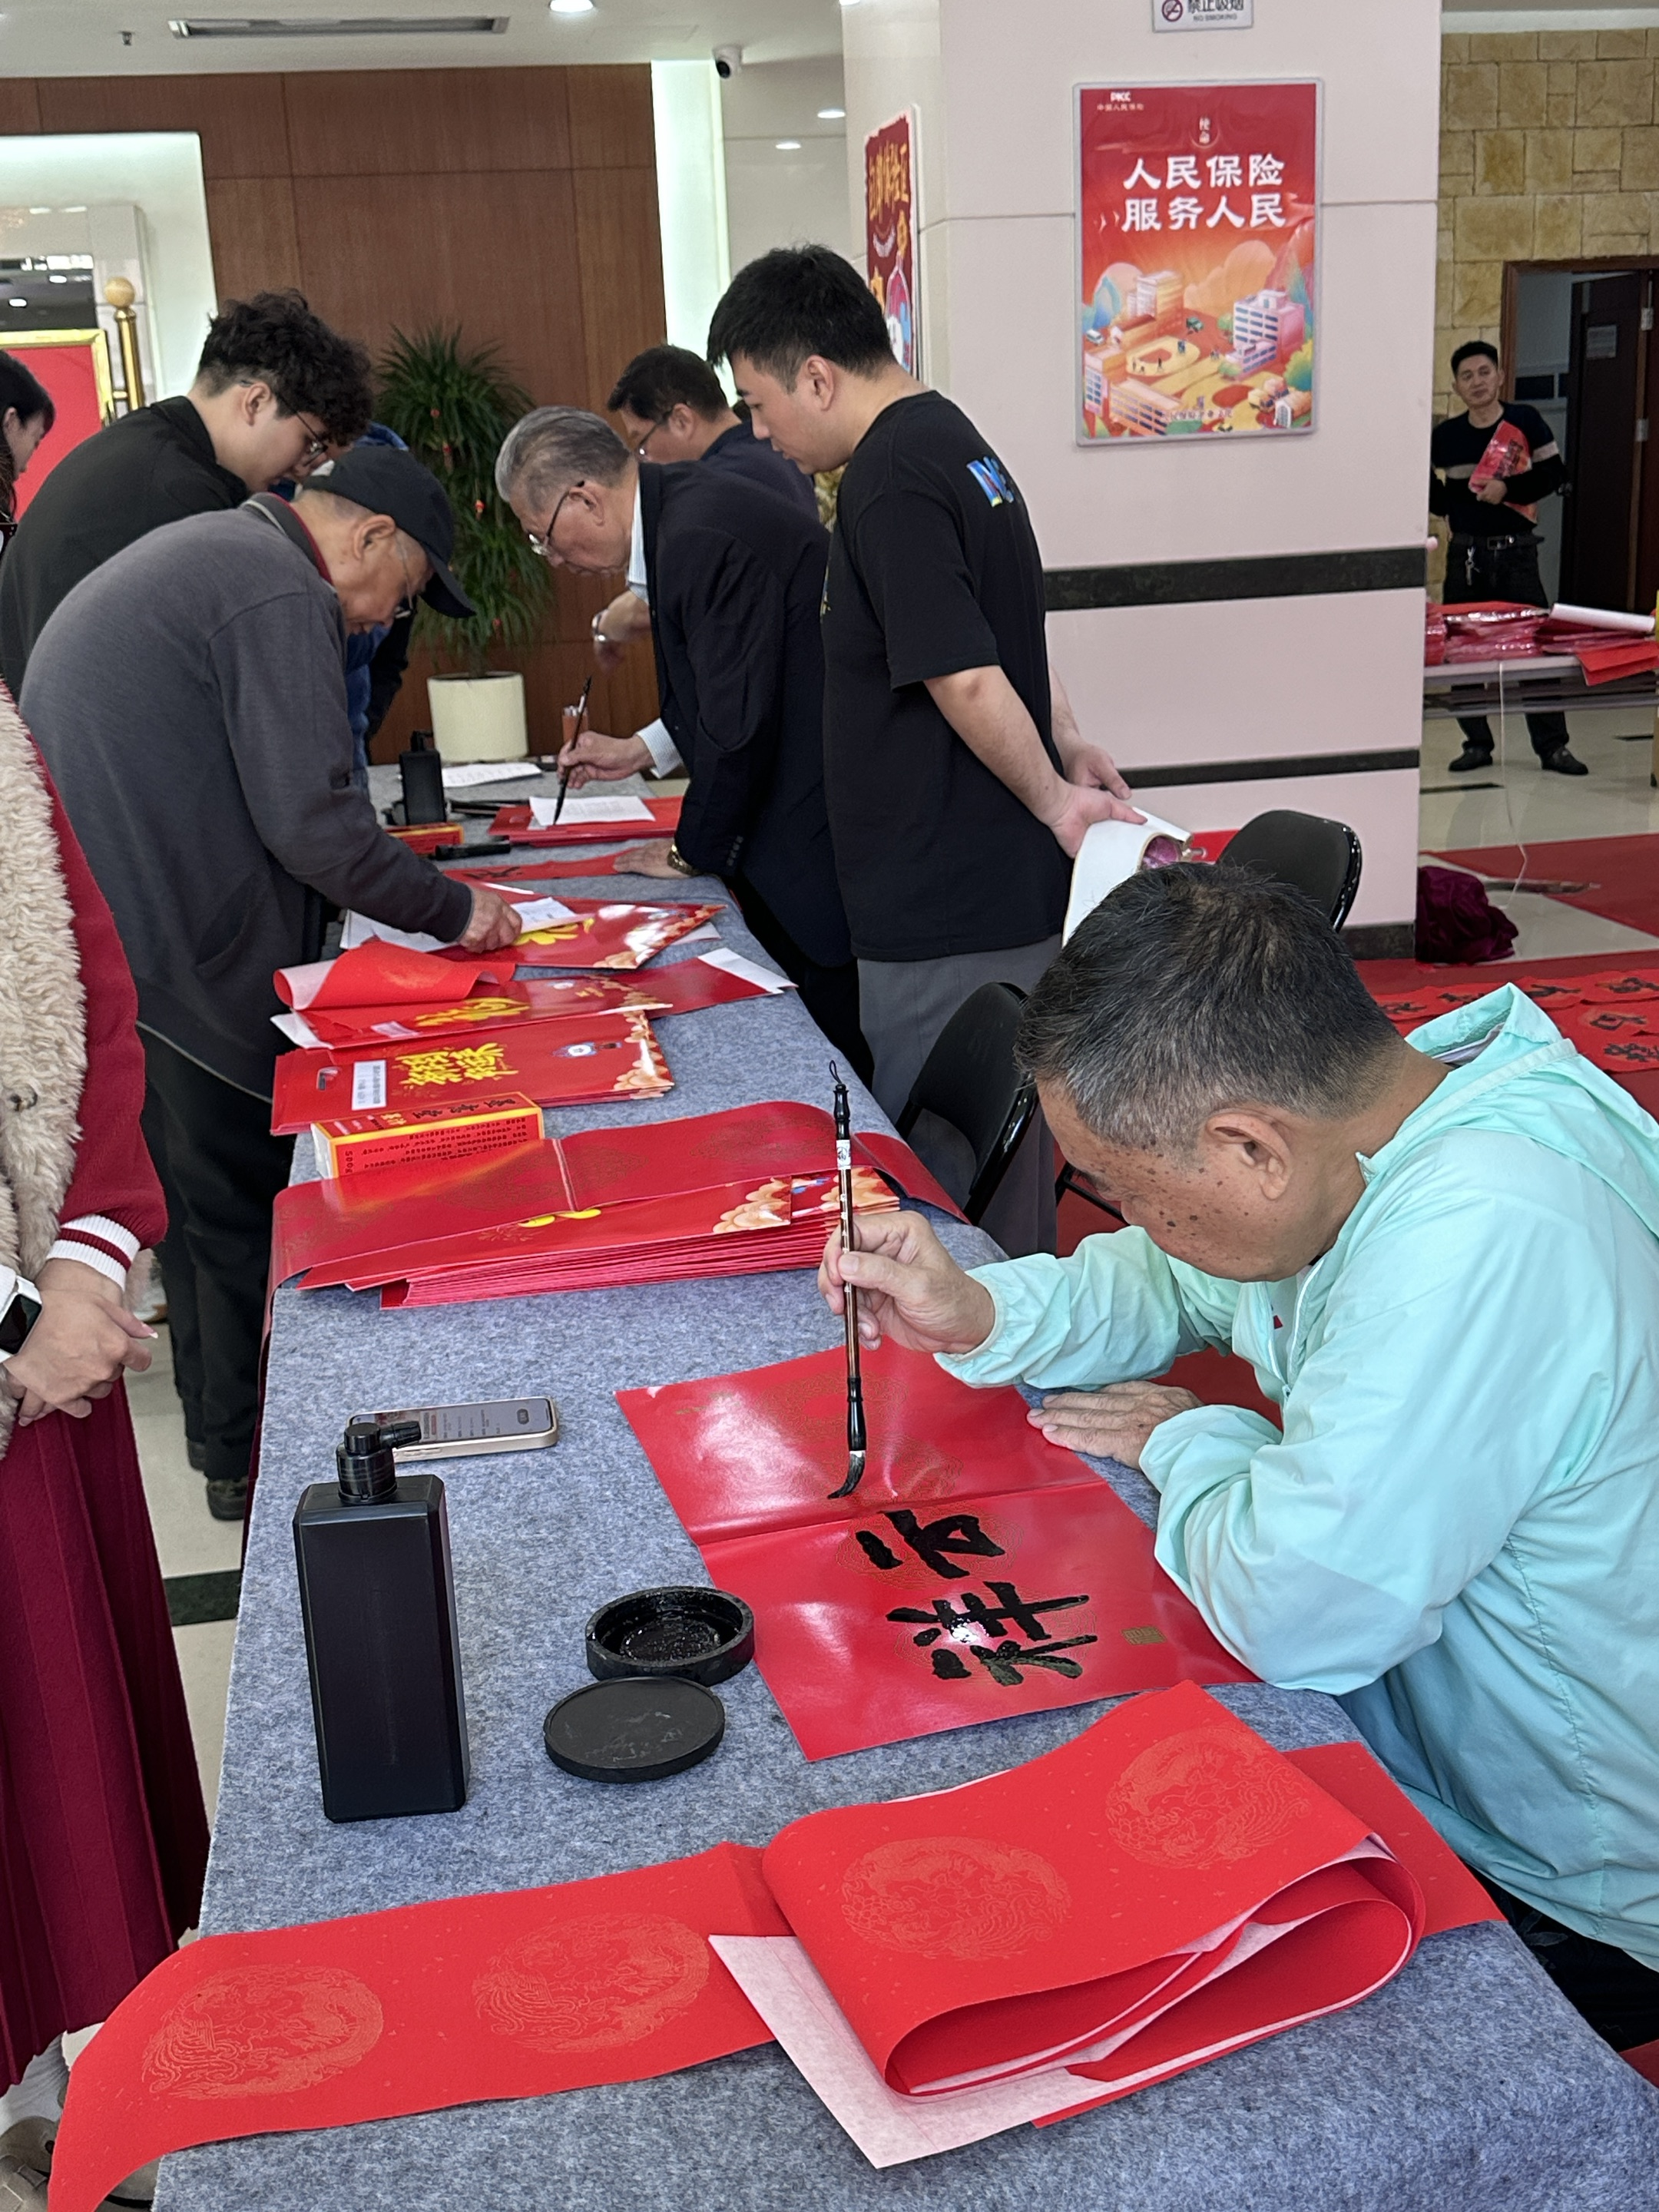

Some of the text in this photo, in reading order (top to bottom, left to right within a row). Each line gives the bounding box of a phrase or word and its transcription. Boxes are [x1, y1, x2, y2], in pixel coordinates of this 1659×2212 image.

[1123, 154, 1285, 190] 人民保险
[1121, 193, 1286, 232] 服务人民
